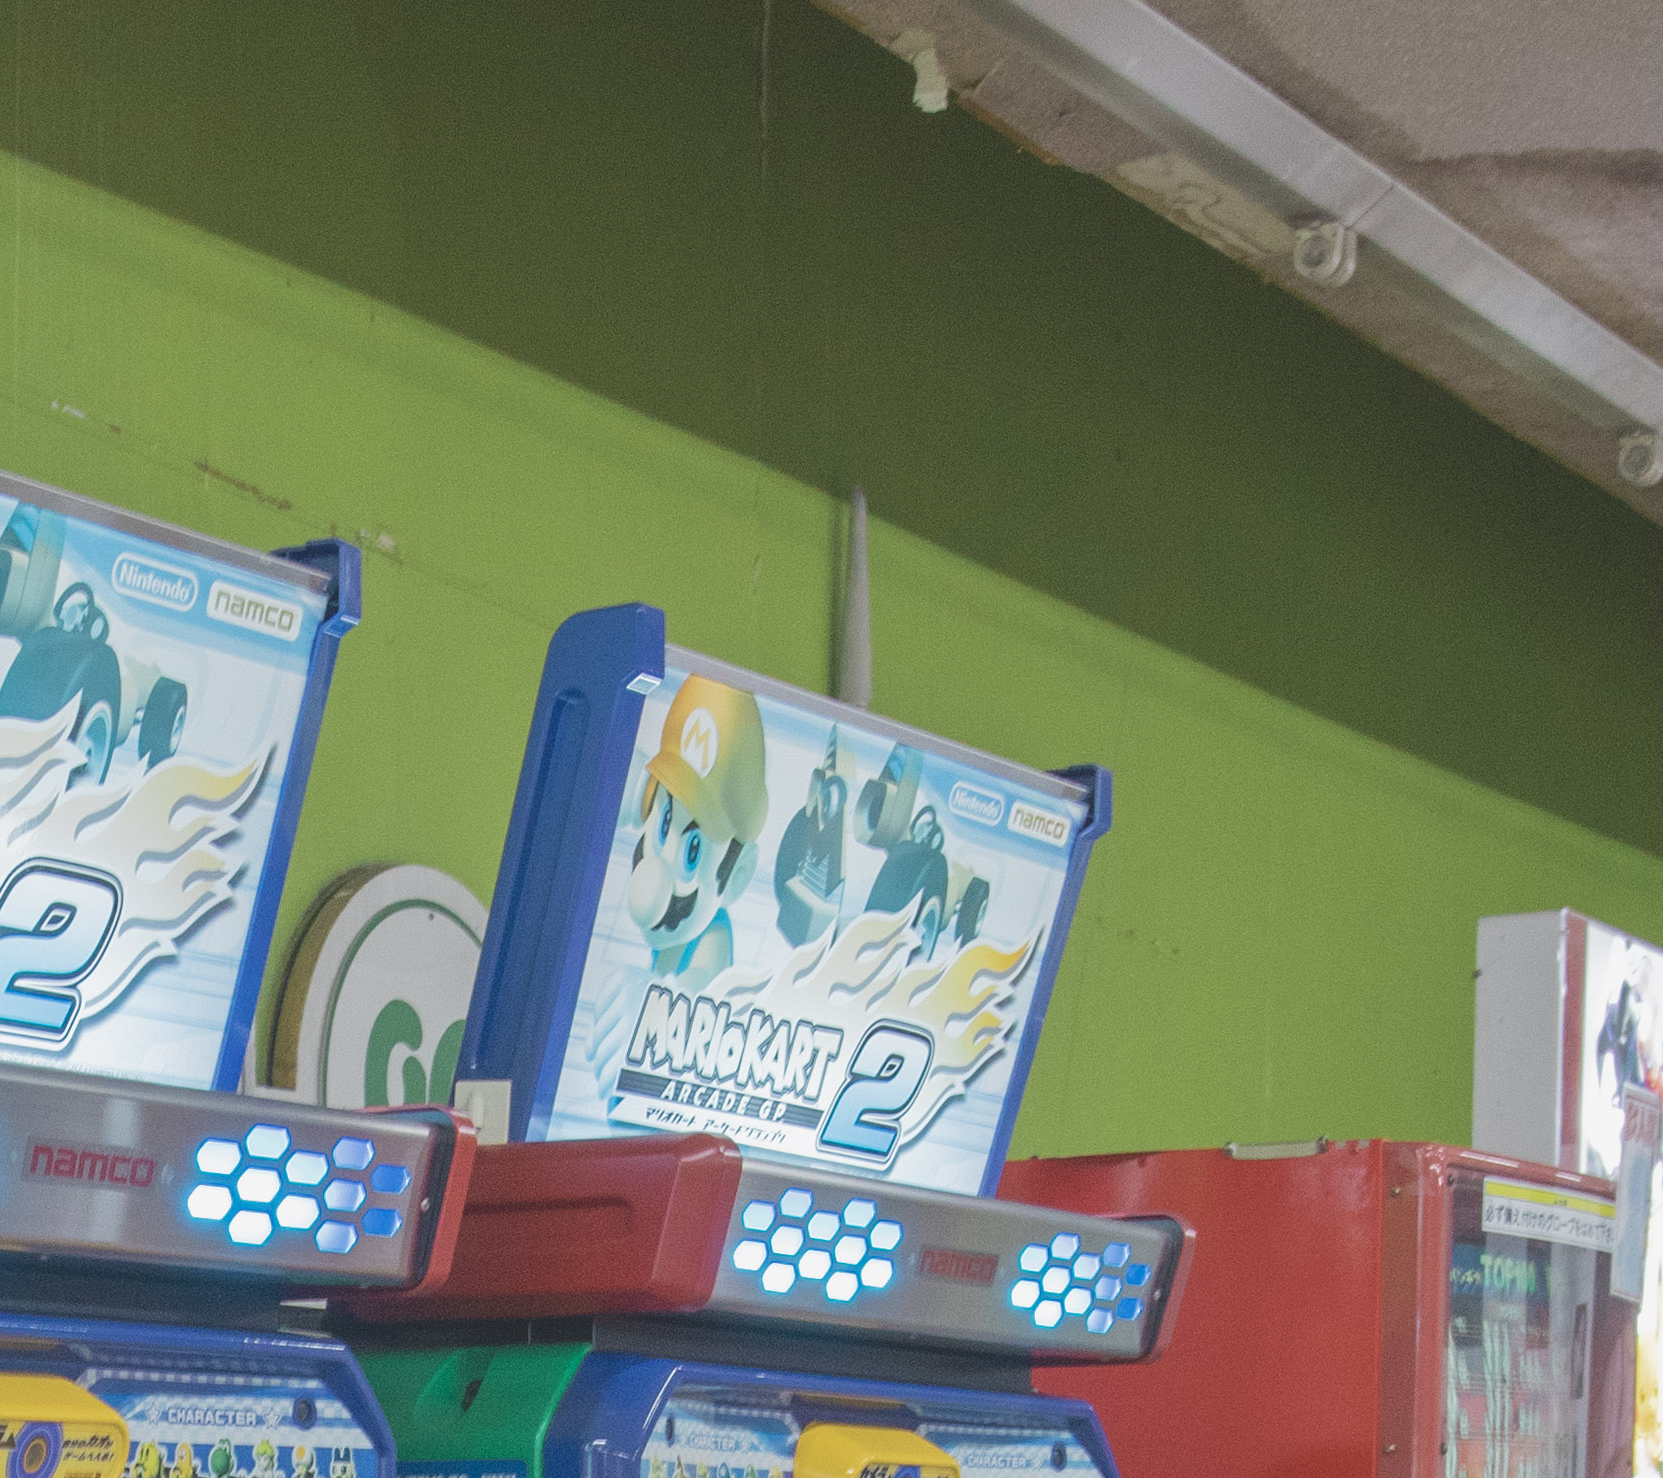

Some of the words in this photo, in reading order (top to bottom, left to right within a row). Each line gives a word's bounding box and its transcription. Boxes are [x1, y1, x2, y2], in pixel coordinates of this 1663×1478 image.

[117, 561, 194, 606] Nintendo
[215, 588, 296, 633] namco
[951, 787, 1001, 820] Nintendo
[1012, 806, 1066, 841] namco
[660, 1083, 751, 1114] ARCADE
[759, 1102, 787, 1124] GP
[28, 1141, 155, 1190] namco
[166, 1406, 257, 1427] CHARACTER
